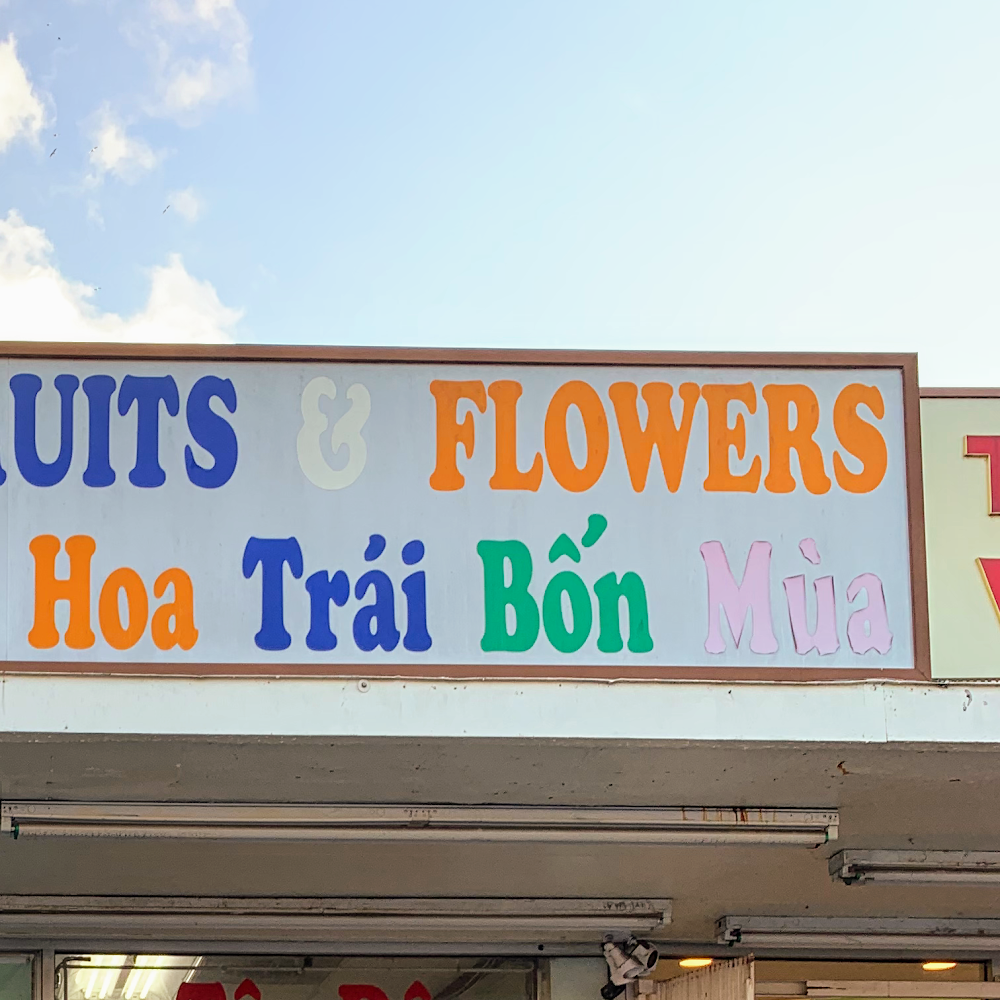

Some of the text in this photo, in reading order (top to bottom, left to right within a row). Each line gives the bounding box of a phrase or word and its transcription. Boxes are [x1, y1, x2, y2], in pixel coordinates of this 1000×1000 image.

[297, 376, 371, 490] &
[429, 379, 888, 495] FLOWERS
[28, 535, 199, 650] Hoa
[242, 534, 433, 652] Trái
[477, 514, 654, 653] Bốn
[700, 537, 894, 656] Mùa
